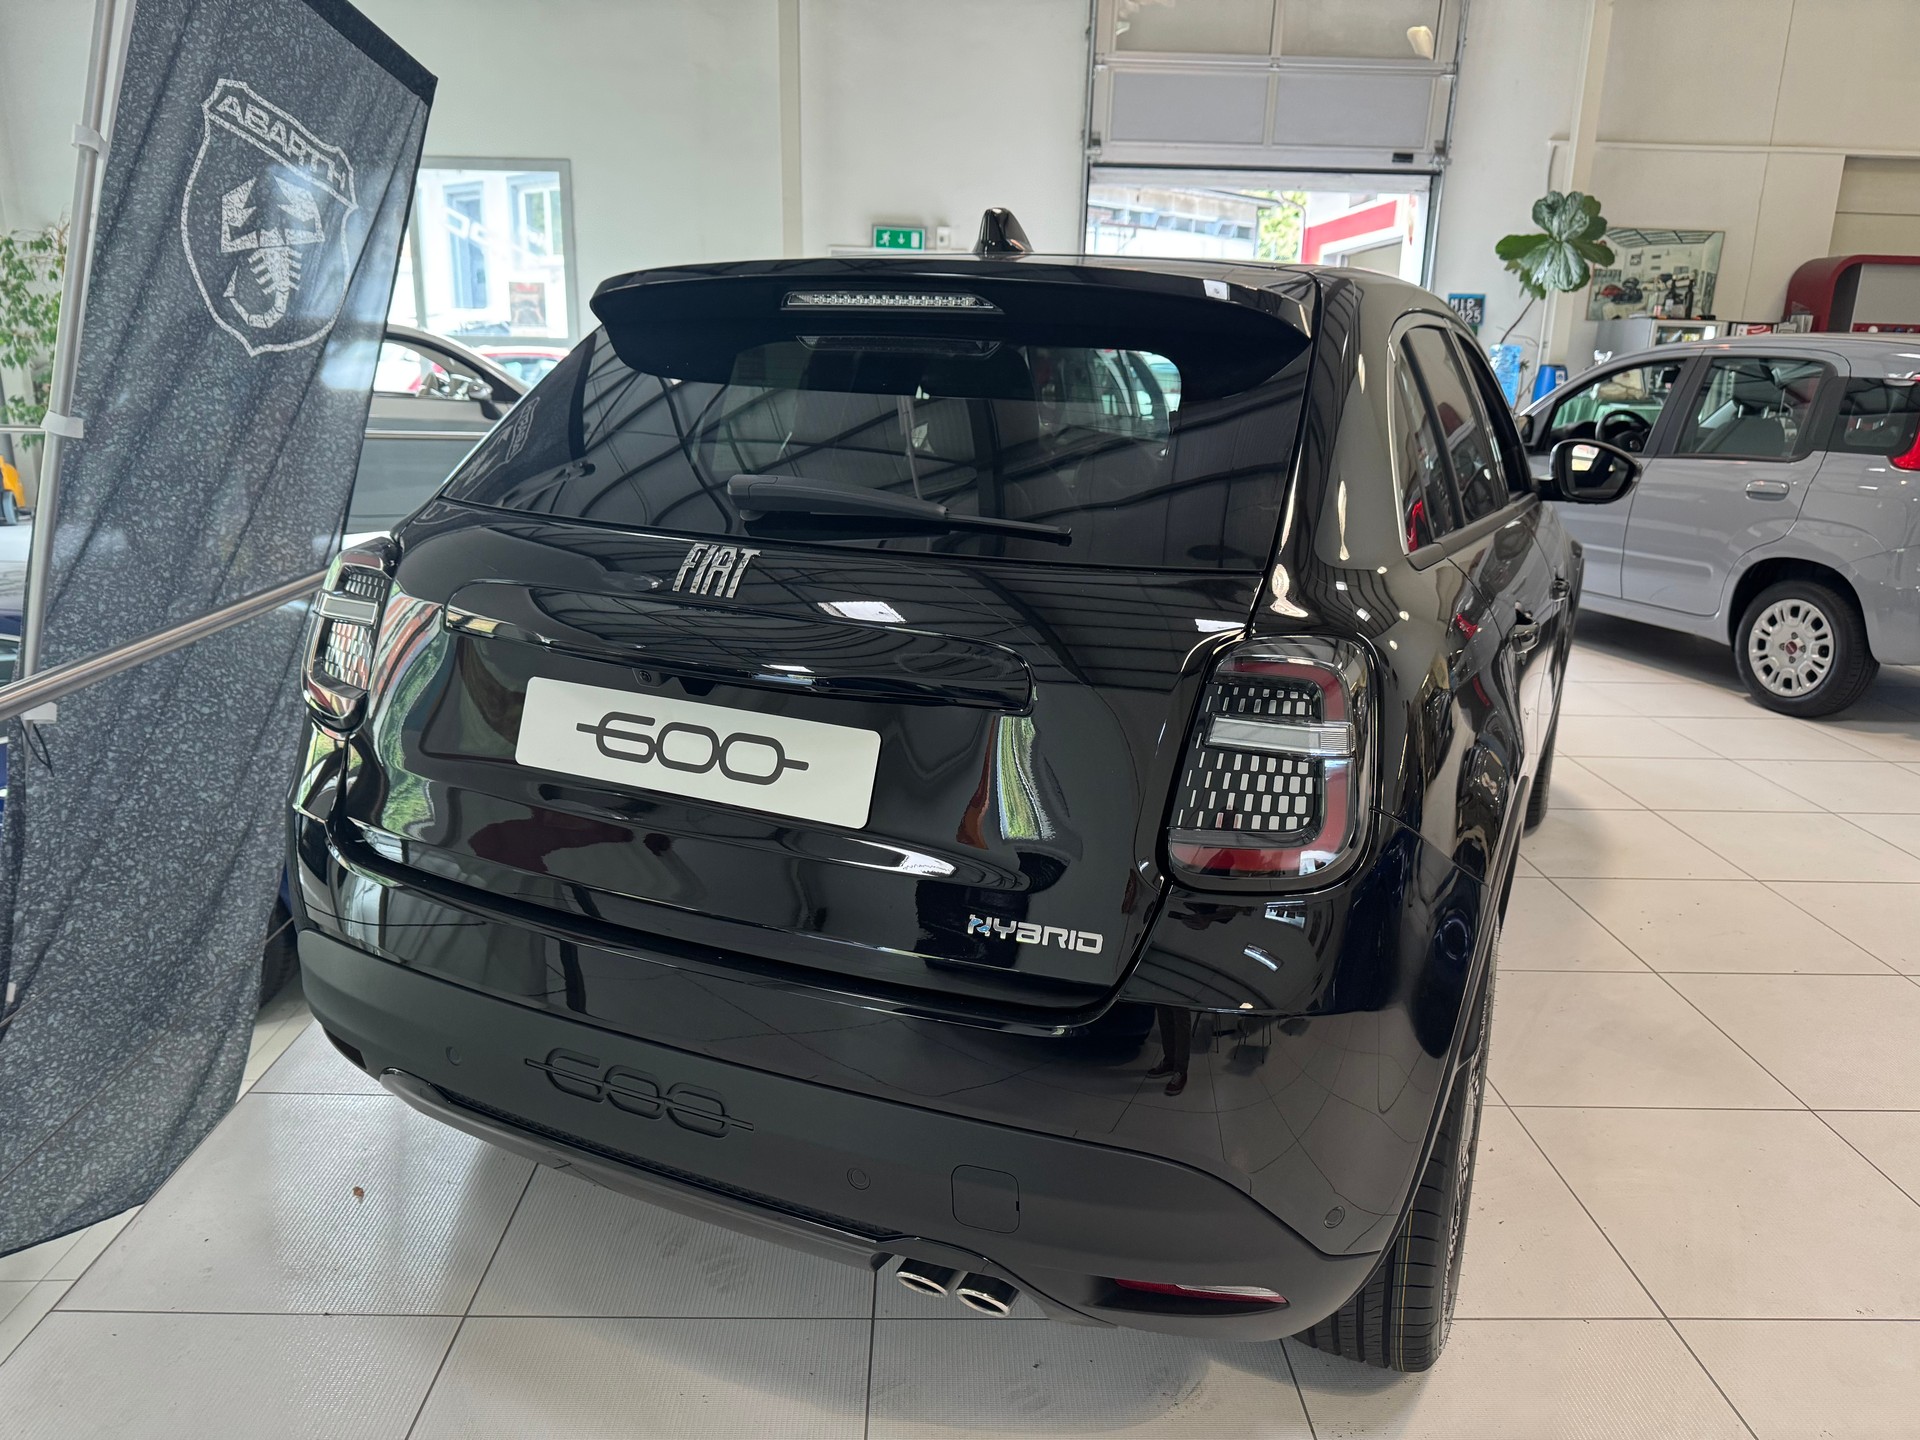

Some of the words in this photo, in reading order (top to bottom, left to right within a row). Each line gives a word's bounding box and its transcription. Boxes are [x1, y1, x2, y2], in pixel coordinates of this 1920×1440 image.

[216, 94, 347, 191] ABARTH
[672, 543, 761, 598] FIAT
[576, 711, 809, 786] 600
[967, 913, 1104, 954] HYBRID
